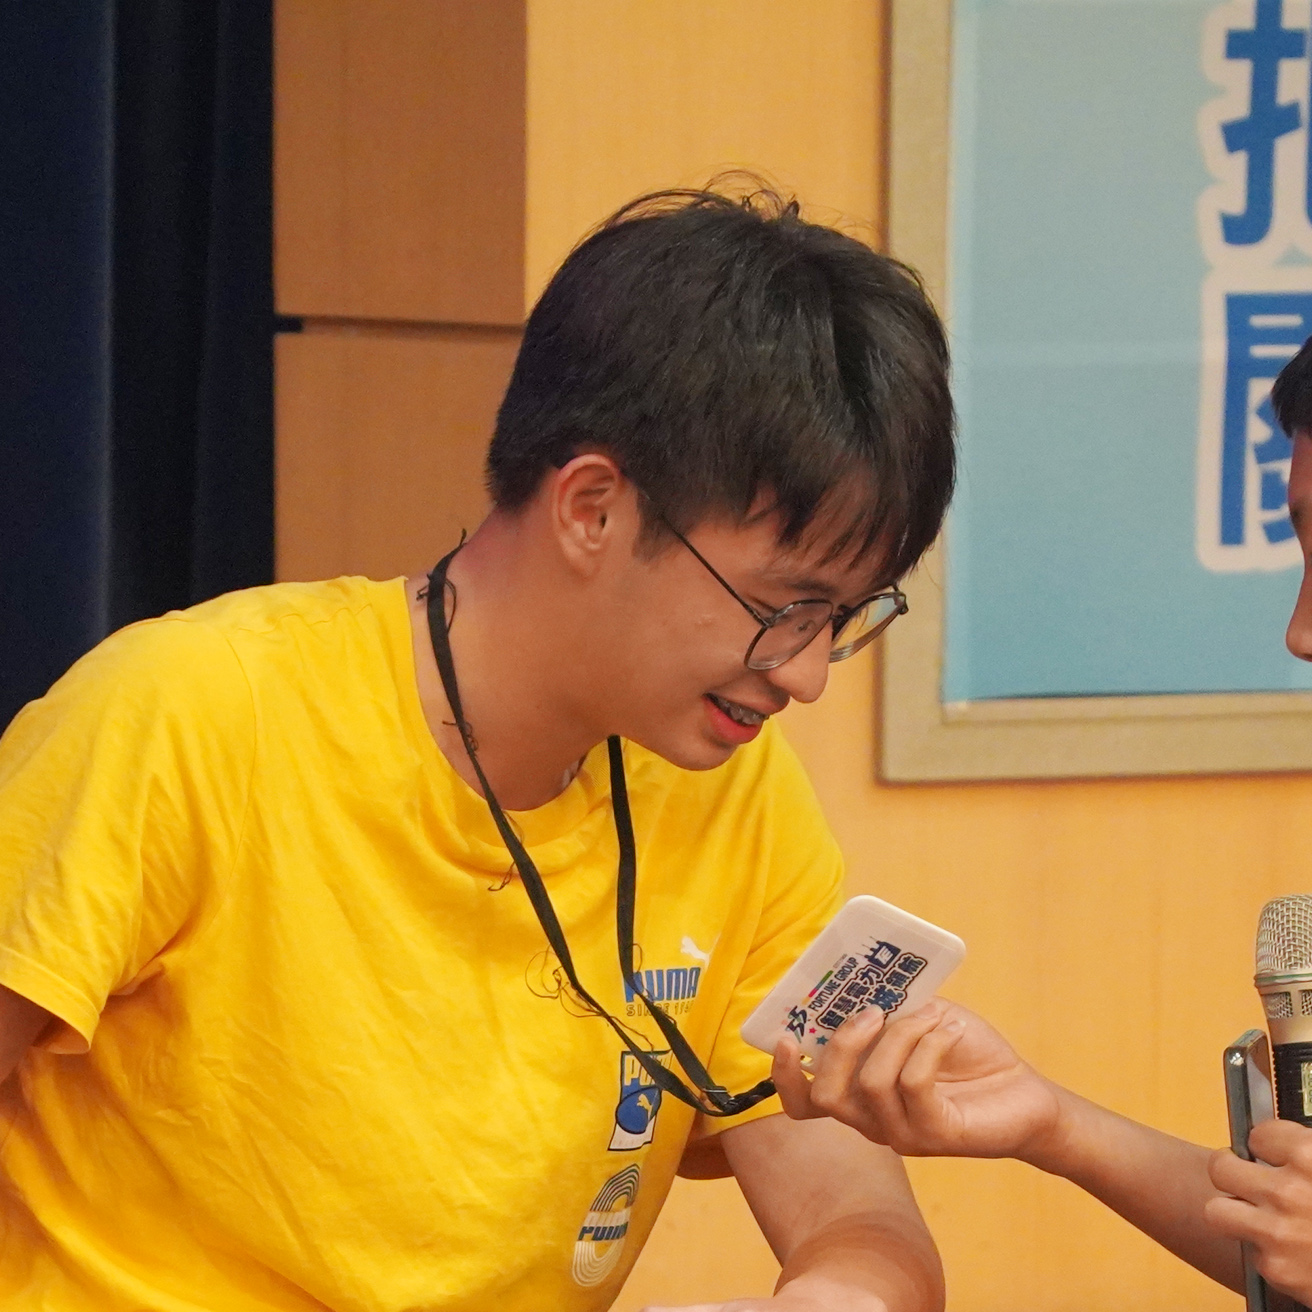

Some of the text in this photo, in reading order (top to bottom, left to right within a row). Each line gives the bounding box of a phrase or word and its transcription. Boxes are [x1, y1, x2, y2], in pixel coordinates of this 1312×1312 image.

[808, 979, 841, 1012] FORTUNE
[834, 957, 859, 983] GROUP
[819, 965, 884, 1029] 智慧電力
[856, 954, 924, 1013] 城領航
